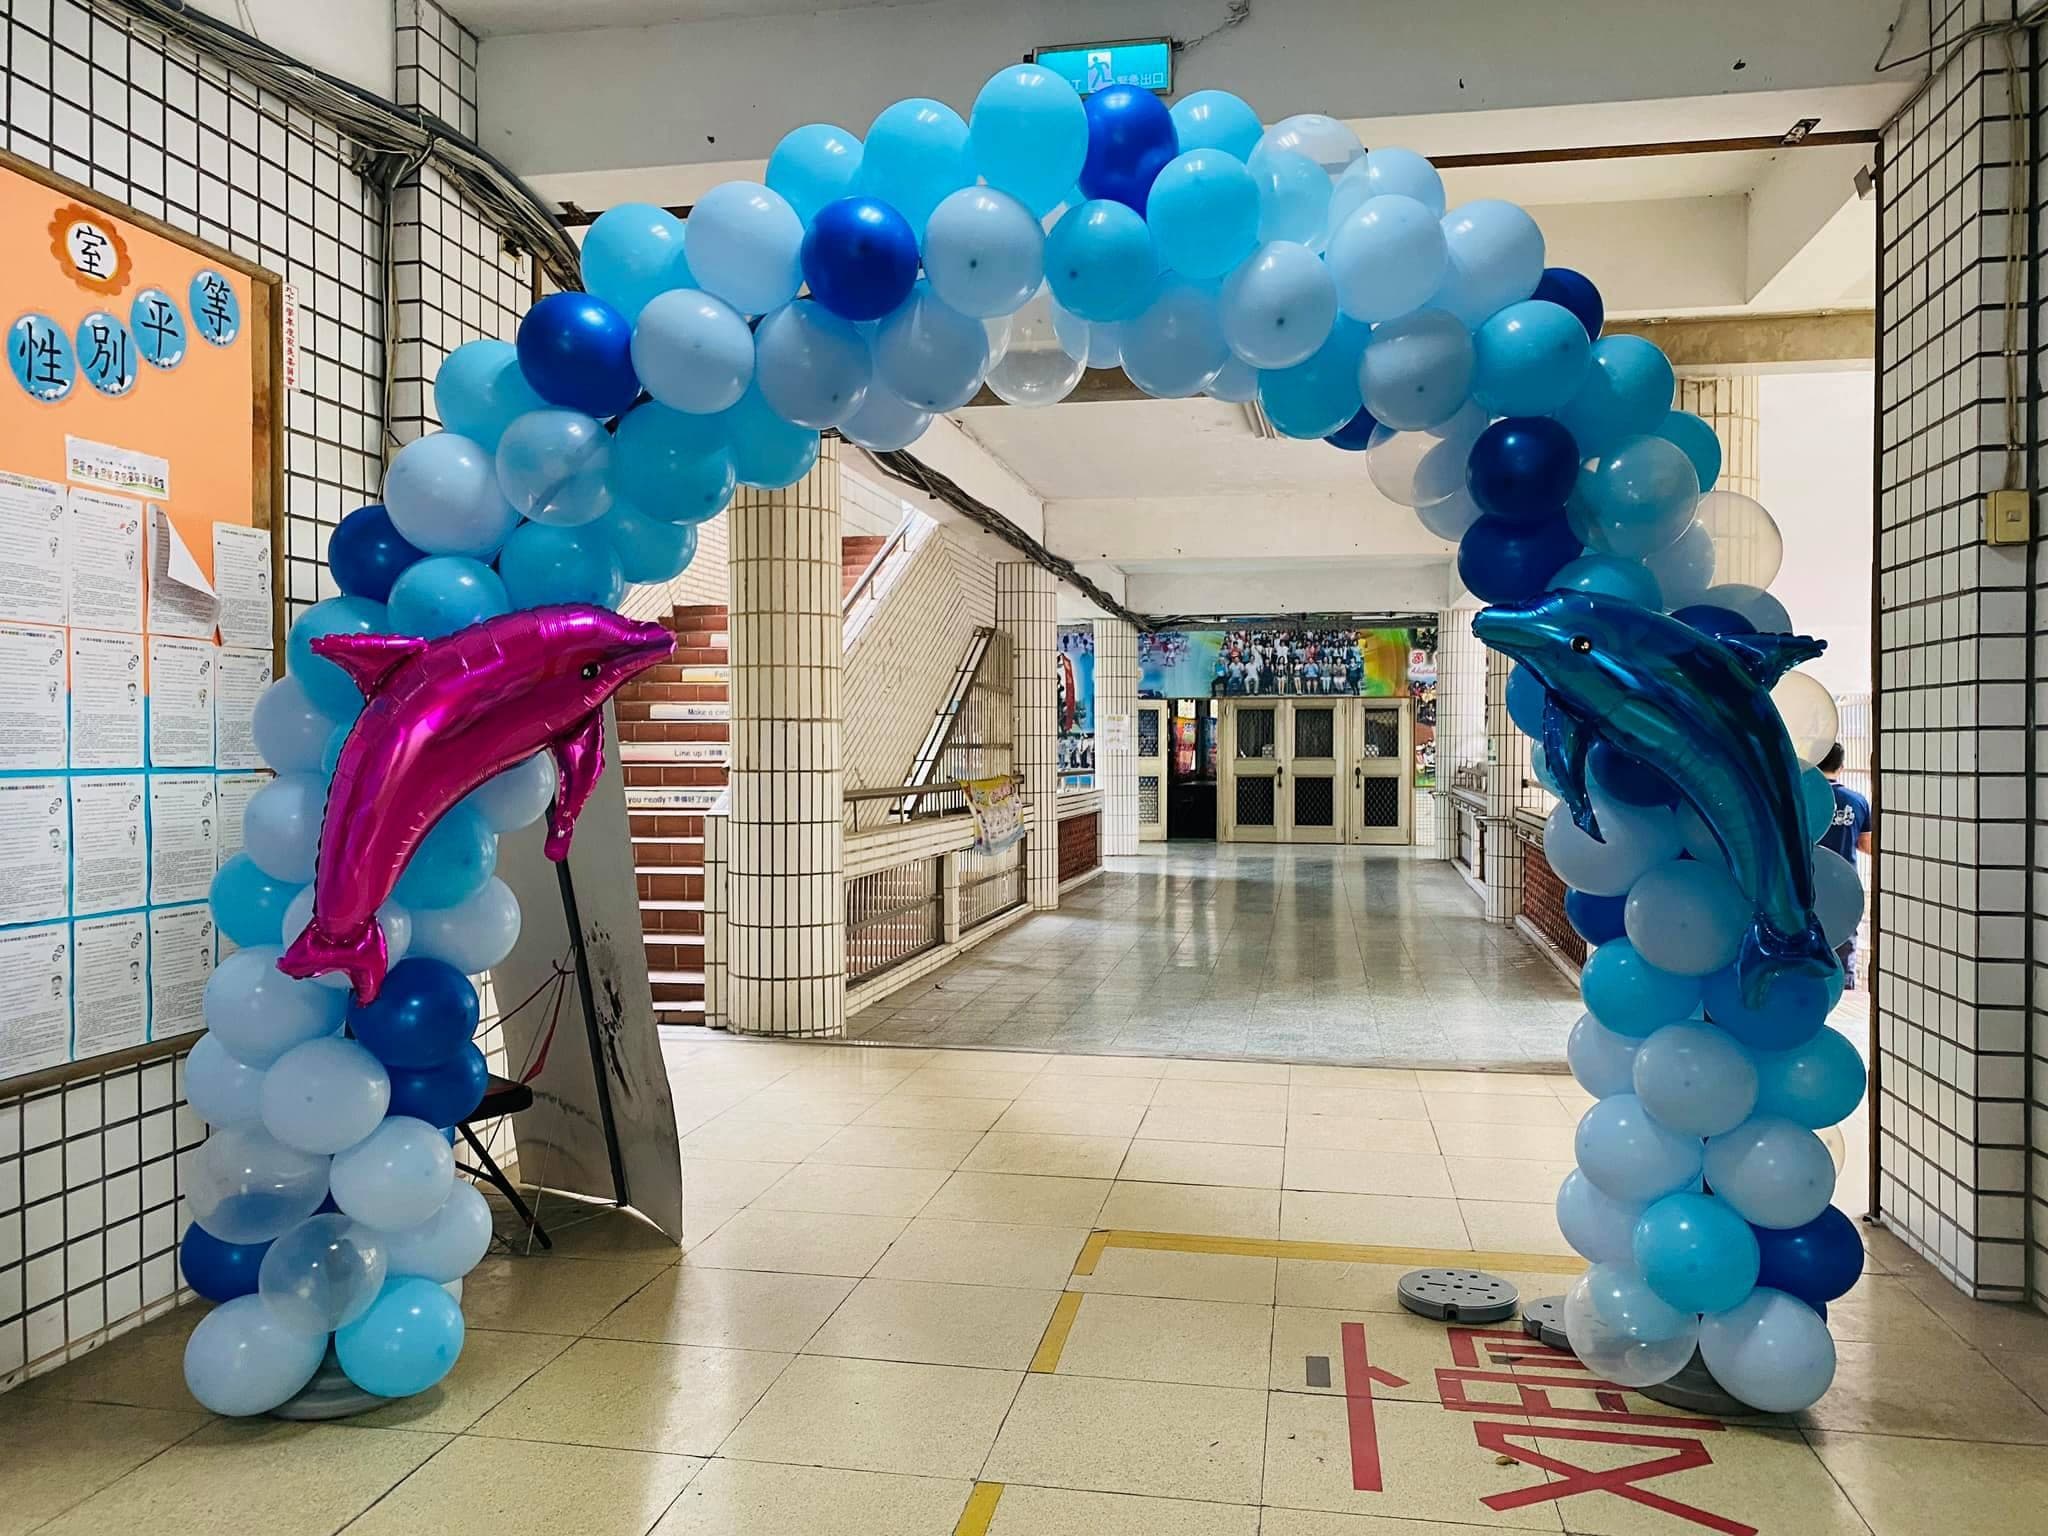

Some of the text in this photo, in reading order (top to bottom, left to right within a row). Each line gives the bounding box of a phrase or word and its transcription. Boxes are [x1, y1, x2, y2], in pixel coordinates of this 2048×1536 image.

[75, 225, 107, 280] 室
[19, 276, 233, 388] 性別平等
[688, 708, 705, 716] Make
[674, 749, 691, 757] Line
[628, 797, 642, 805] you
